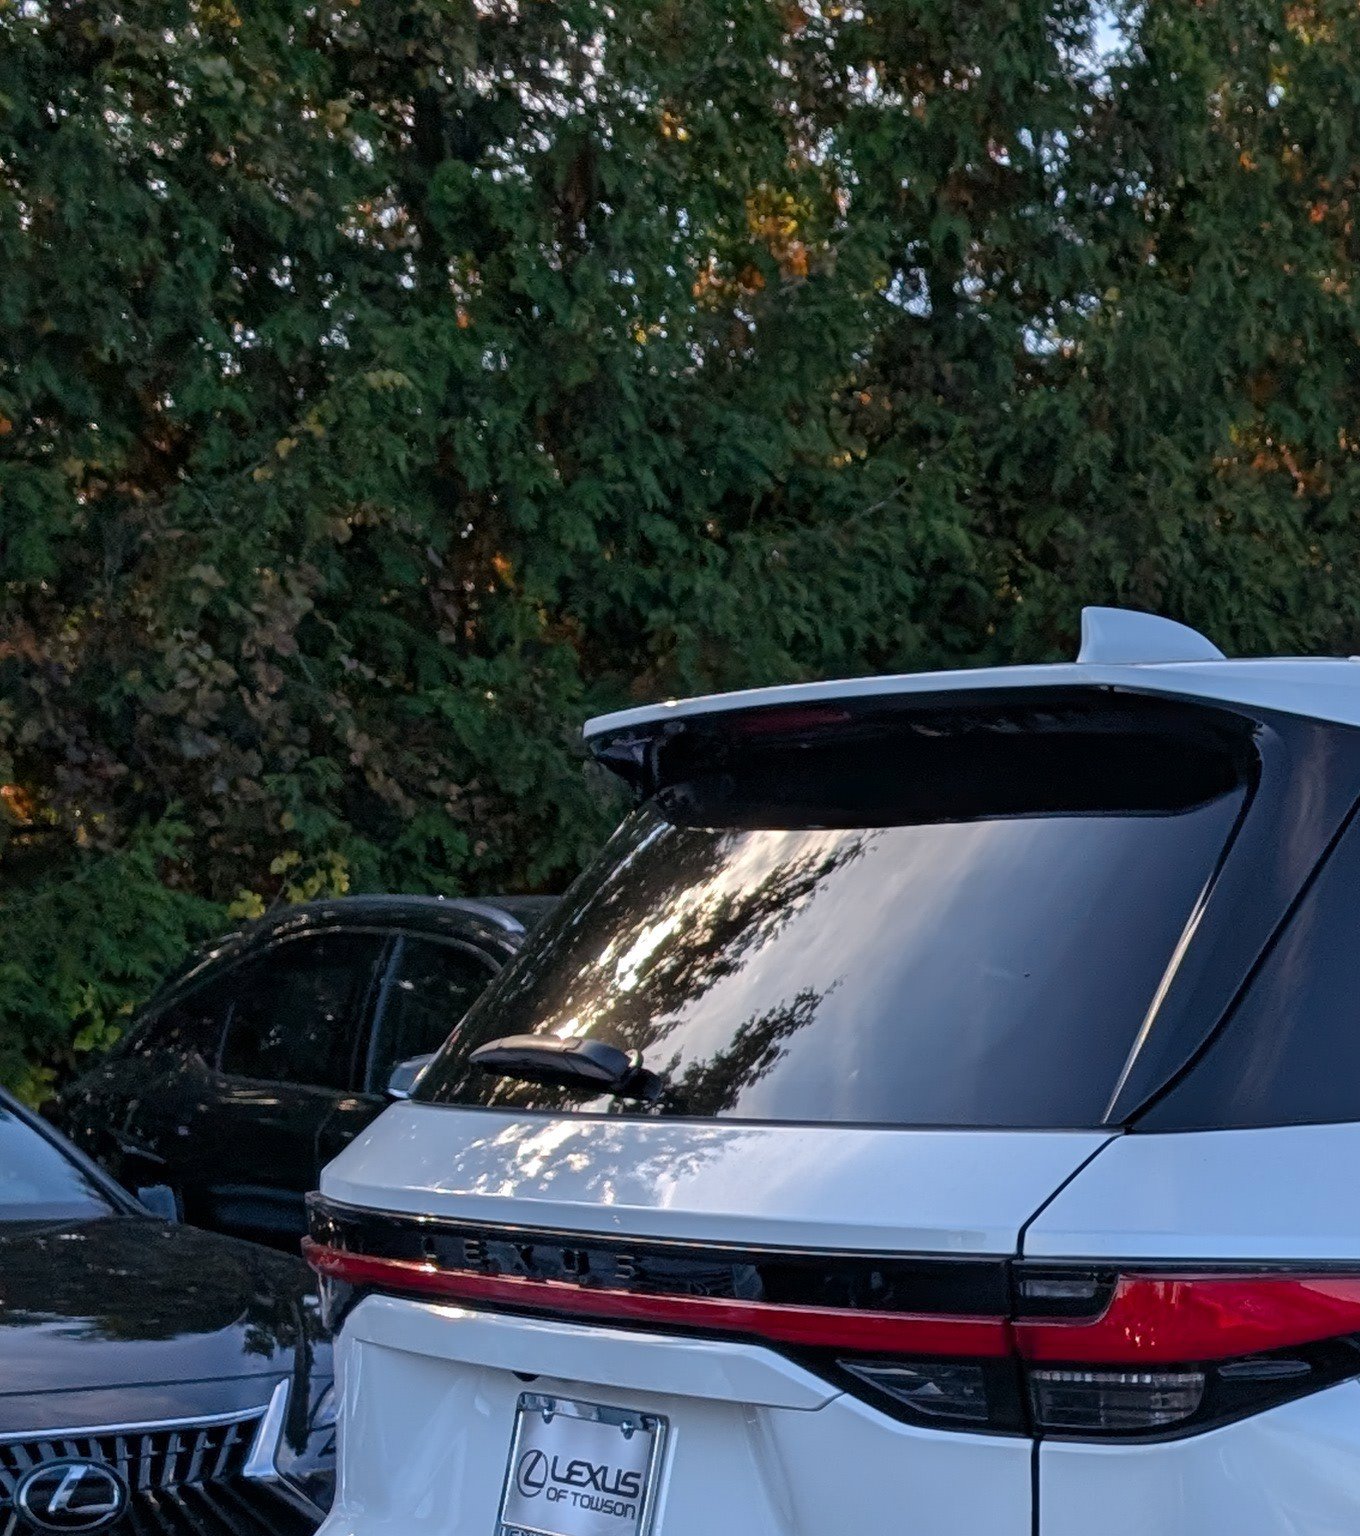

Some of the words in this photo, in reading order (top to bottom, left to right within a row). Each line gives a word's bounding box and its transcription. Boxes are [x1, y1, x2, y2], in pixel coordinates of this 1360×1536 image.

[551, 1455, 641, 1499] LEXUS
[546, 1486, 569, 1502] OF
[571, 1492, 636, 1520] TOWSON
